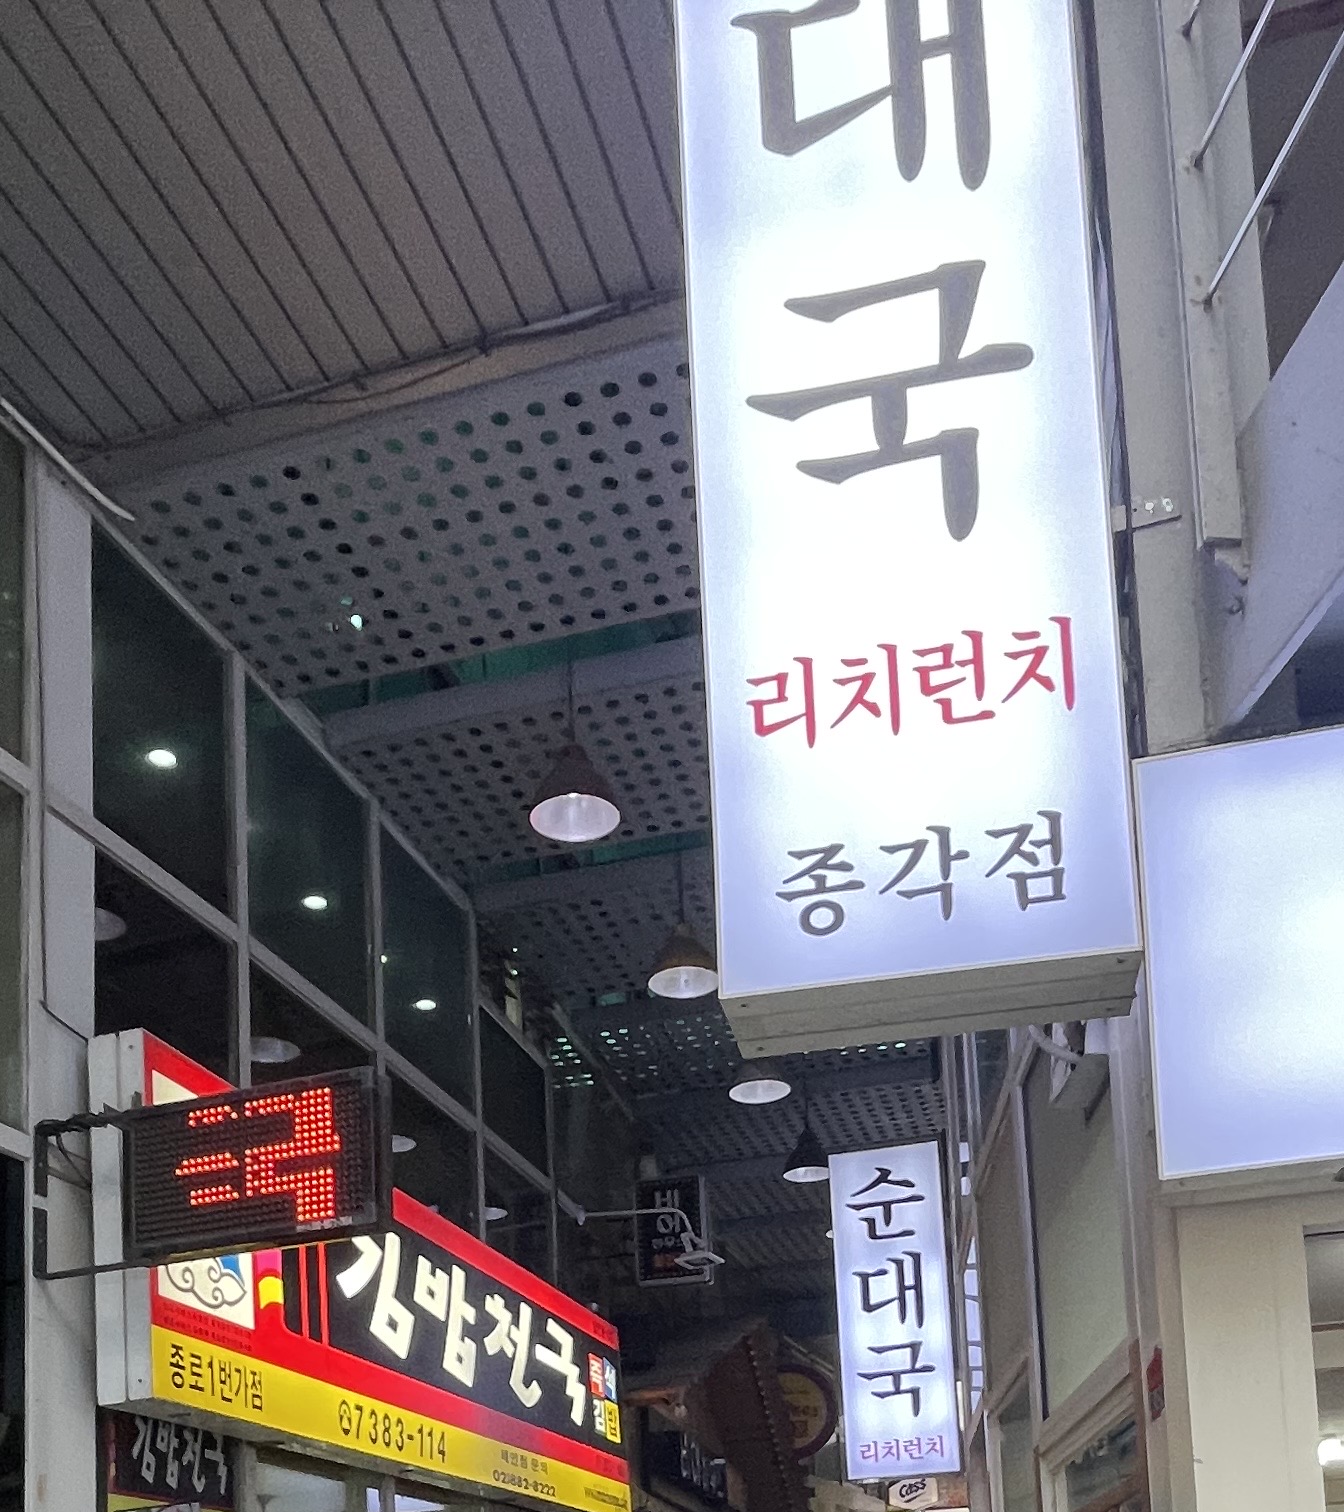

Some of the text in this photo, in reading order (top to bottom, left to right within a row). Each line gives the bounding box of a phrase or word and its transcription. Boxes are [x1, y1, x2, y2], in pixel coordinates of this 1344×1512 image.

[746, 616, 1077, 749] 리치런치
[775, 810, 1068, 937] 종각점
[336, 1232, 586, 1426] 김밥천국
[846, 1167, 935, 1417] 순대국
[169, 1343, 263, 1412] 종로1번가점
[133, 1416, 229, 1495] 김밥천국
[355, 1402, 447, 1465] 7383-114
[859, 1436, 946, 1461] 리치런치
